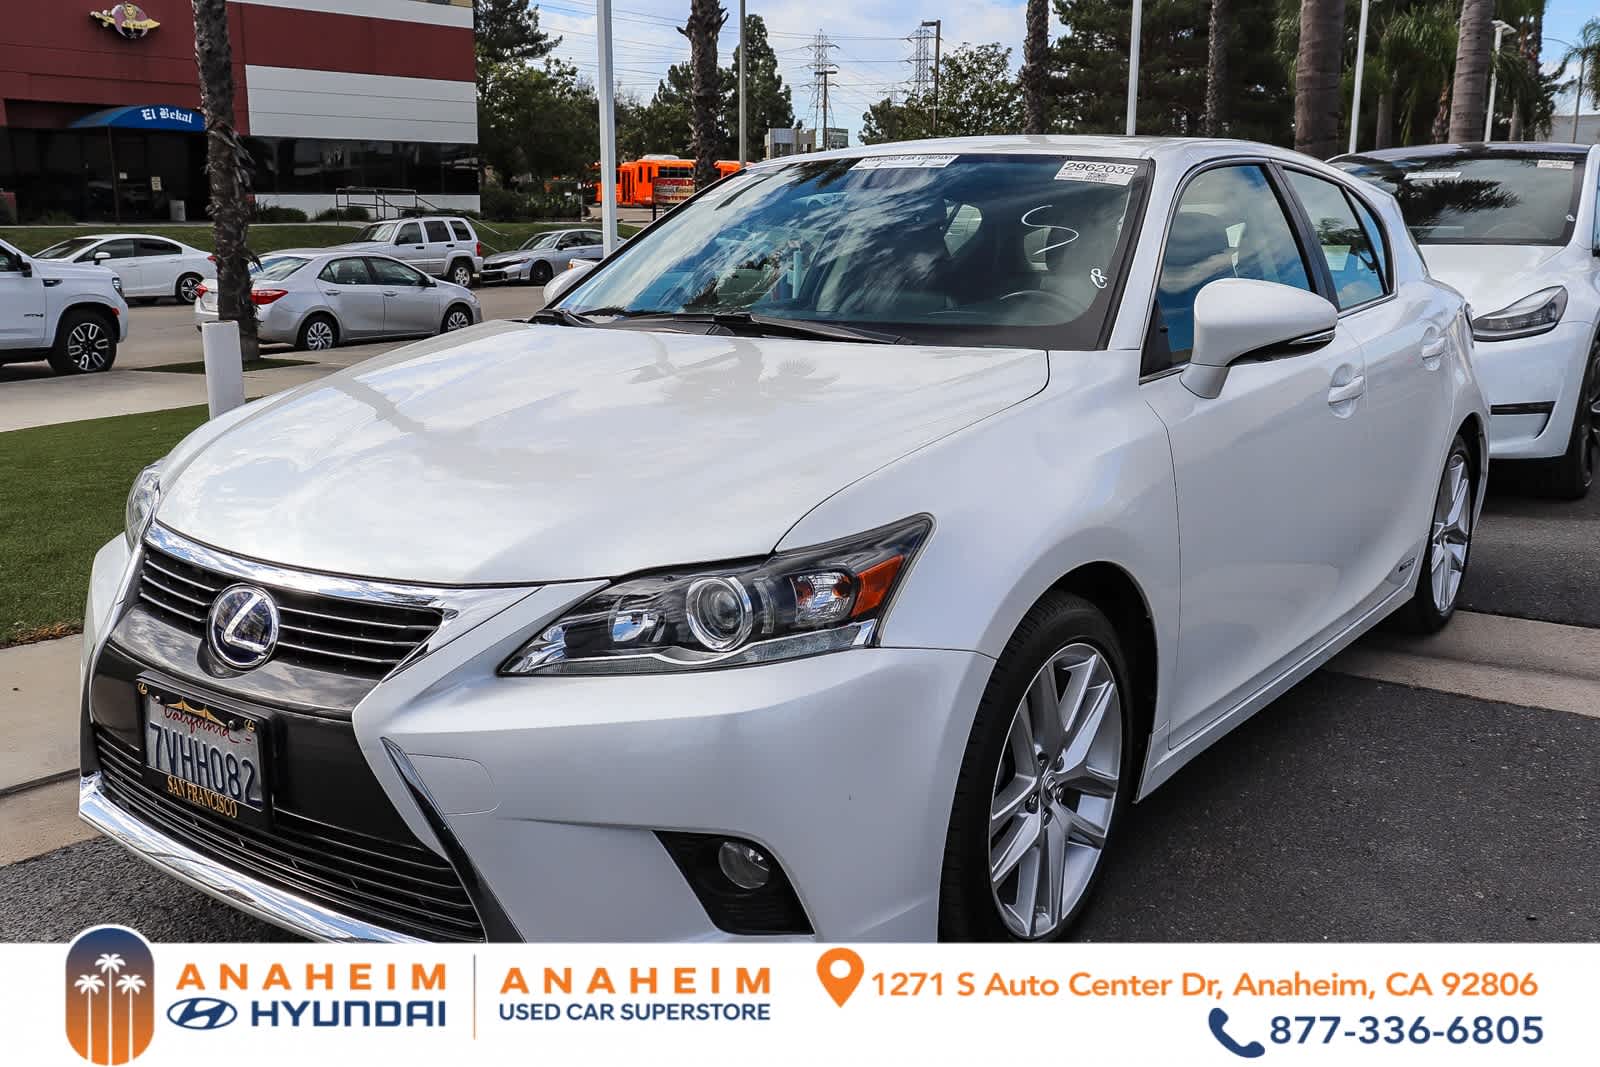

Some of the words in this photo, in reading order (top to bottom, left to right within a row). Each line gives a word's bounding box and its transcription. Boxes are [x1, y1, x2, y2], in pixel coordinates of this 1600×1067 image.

[141, 108, 157, 121] El
[160, 107, 193, 123] Bekal
[1064, 162, 1137, 176] 2962032
[149, 720, 263, 807] 7VHH082
[167, 775, 186, 799] SAN
[187, 782, 238, 819] FRANCISCO
